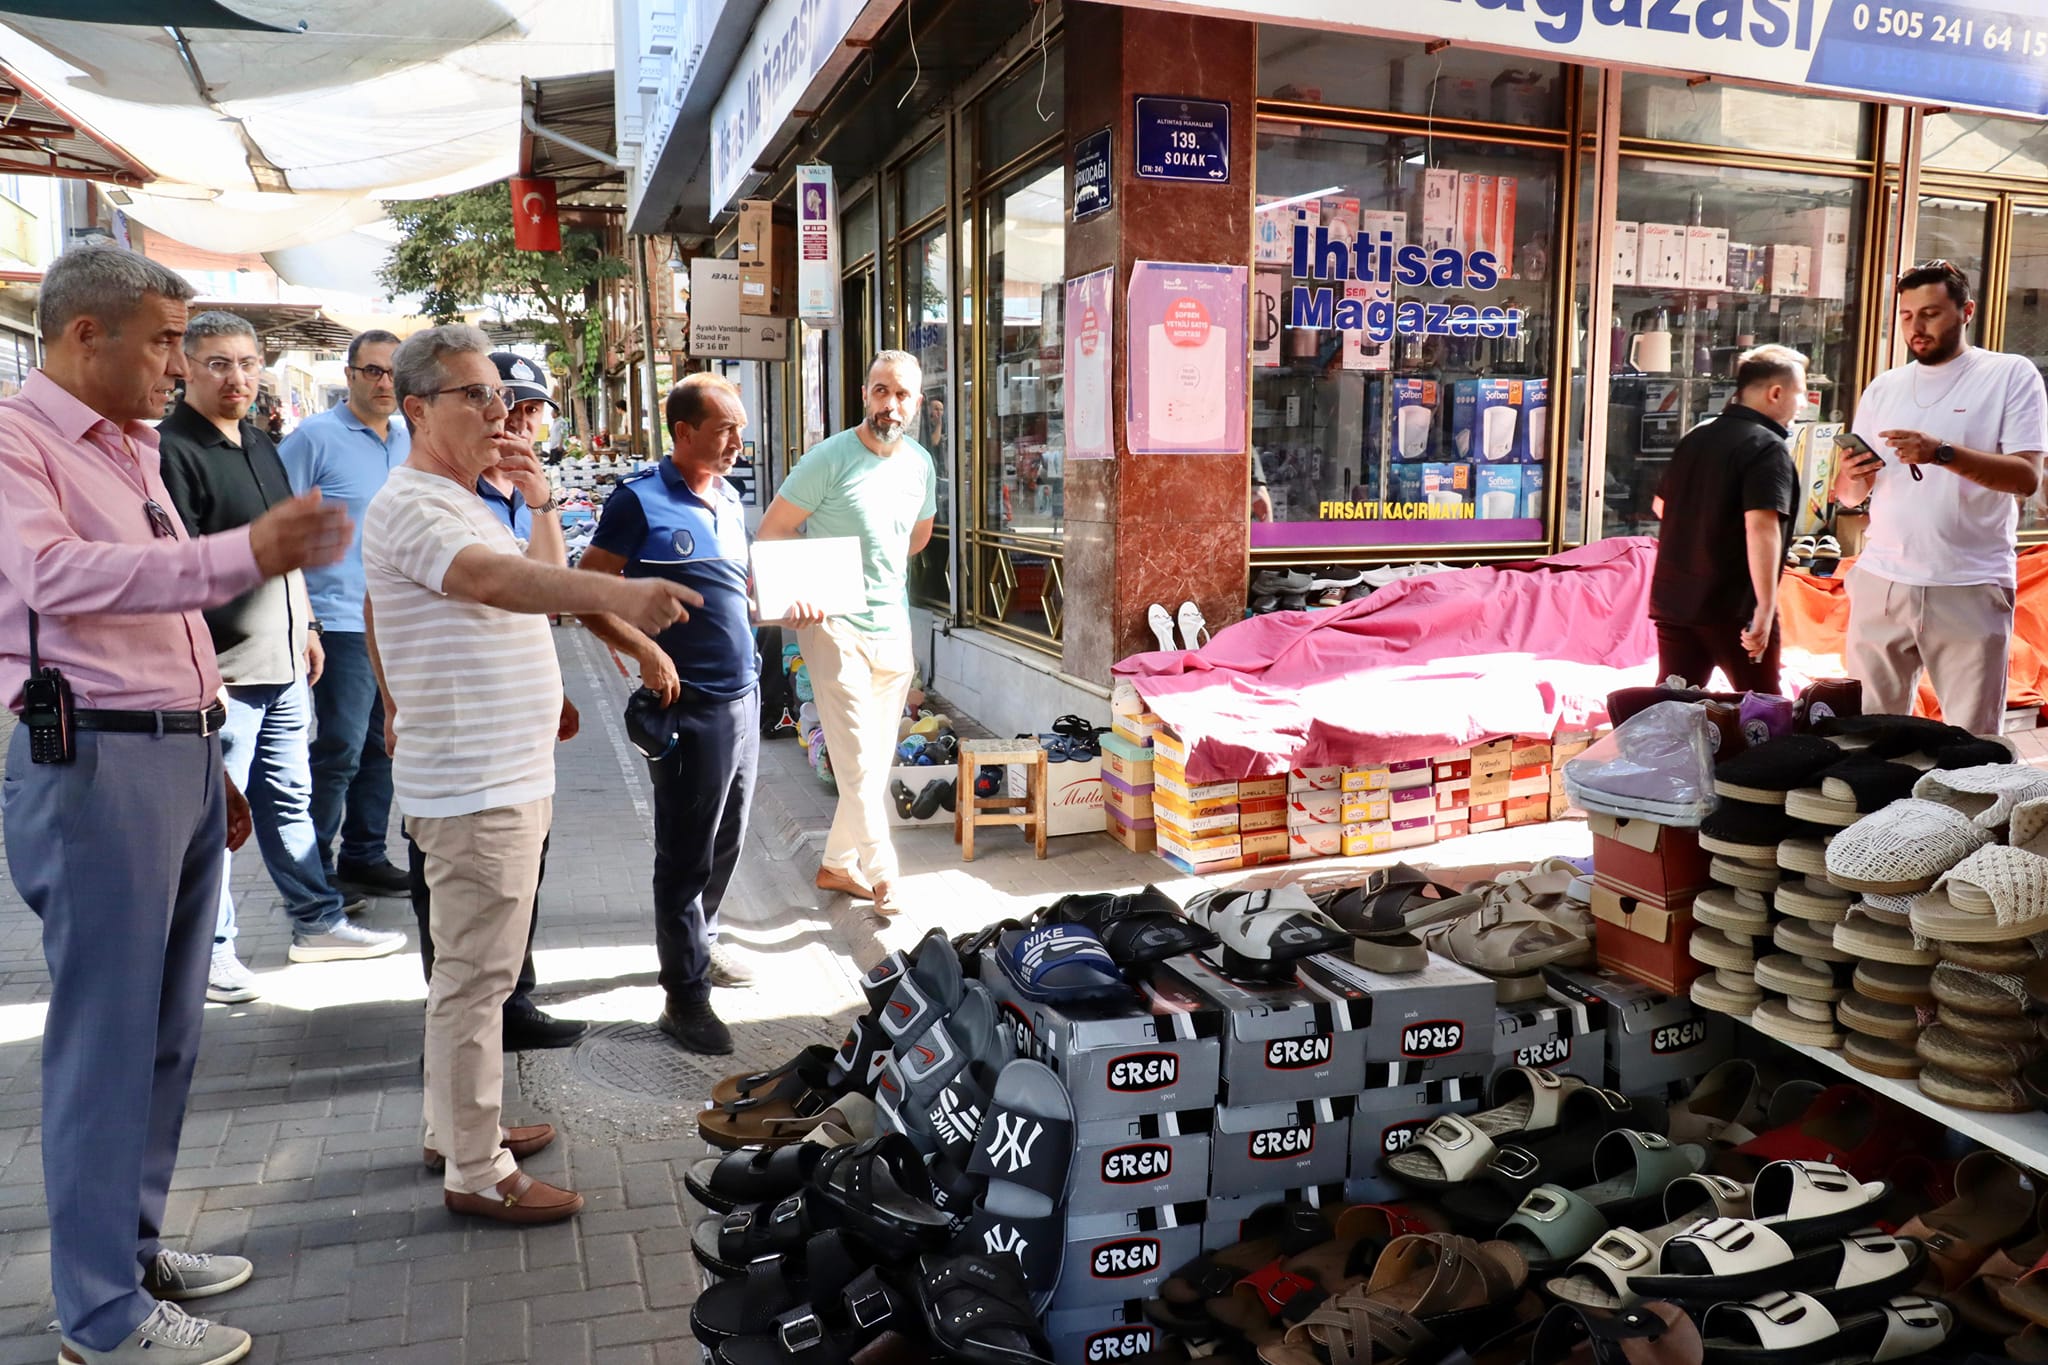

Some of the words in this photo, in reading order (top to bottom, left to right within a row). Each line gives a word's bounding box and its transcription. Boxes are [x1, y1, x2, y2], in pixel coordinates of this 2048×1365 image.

[1853, 3, 1870, 31] 0
[1876, 7, 1924, 38] 505
[1930, 15, 1974, 46] 241
[1983, 24, 2012, 51] 64
[2022, 29, 2048, 57] 15
[1183, 120, 1214, 129] MAHALLESİ
[1171, 130, 1200, 150] 139.
[1165, 151, 1206, 167] SOKAK
[1292, 209, 1499, 290] İhtisas
[1346, 287, 1367, 297] SEM
[1291, 285, 1520, 343] Mağazası
[696, 324, 717, 333] Ayaklı
[696, 333, 716, 341] Stand
[718, 343, 729, 351] BT
[1400, 389, 1423, 400] Şofben
[1486, 390, 1509, 402] Şofben
[1488, 475, 1514, 488] Şofben
[1319, 501, 1378, 520] FIRSATI
[1382, 502, 1475, 521] KAÇIRMAYIN
[1024, 927, 1064, 953] NIKE
[1404, 1025, 1462, 1052] EREN
[1654, 1021, 1705, 1050] EREN
[1268, 1037, 1330, 1065] EREN
[1517, 1038, 1569, 1066] EREN
[1111, 1058, 1175, 1086] EREN
[1314, 1070, 1330, 1079] sport
[1161, 1092, 1177, 1102] sport
[929, 1106, 961, 1146] NIKE
[1252, 1127, 1312, 1156] EREN
[1105, 1150, 1169, 1179] EREN
[1296, 1158, 1312, 1168] sport
[1153, 1183, 1170, 1193] sport
[1094, 1243, 1158, 1274] EREN
[1142, 1276, 1159, 1286] sport
[1088, 1331, 1151, 1362] EREN
